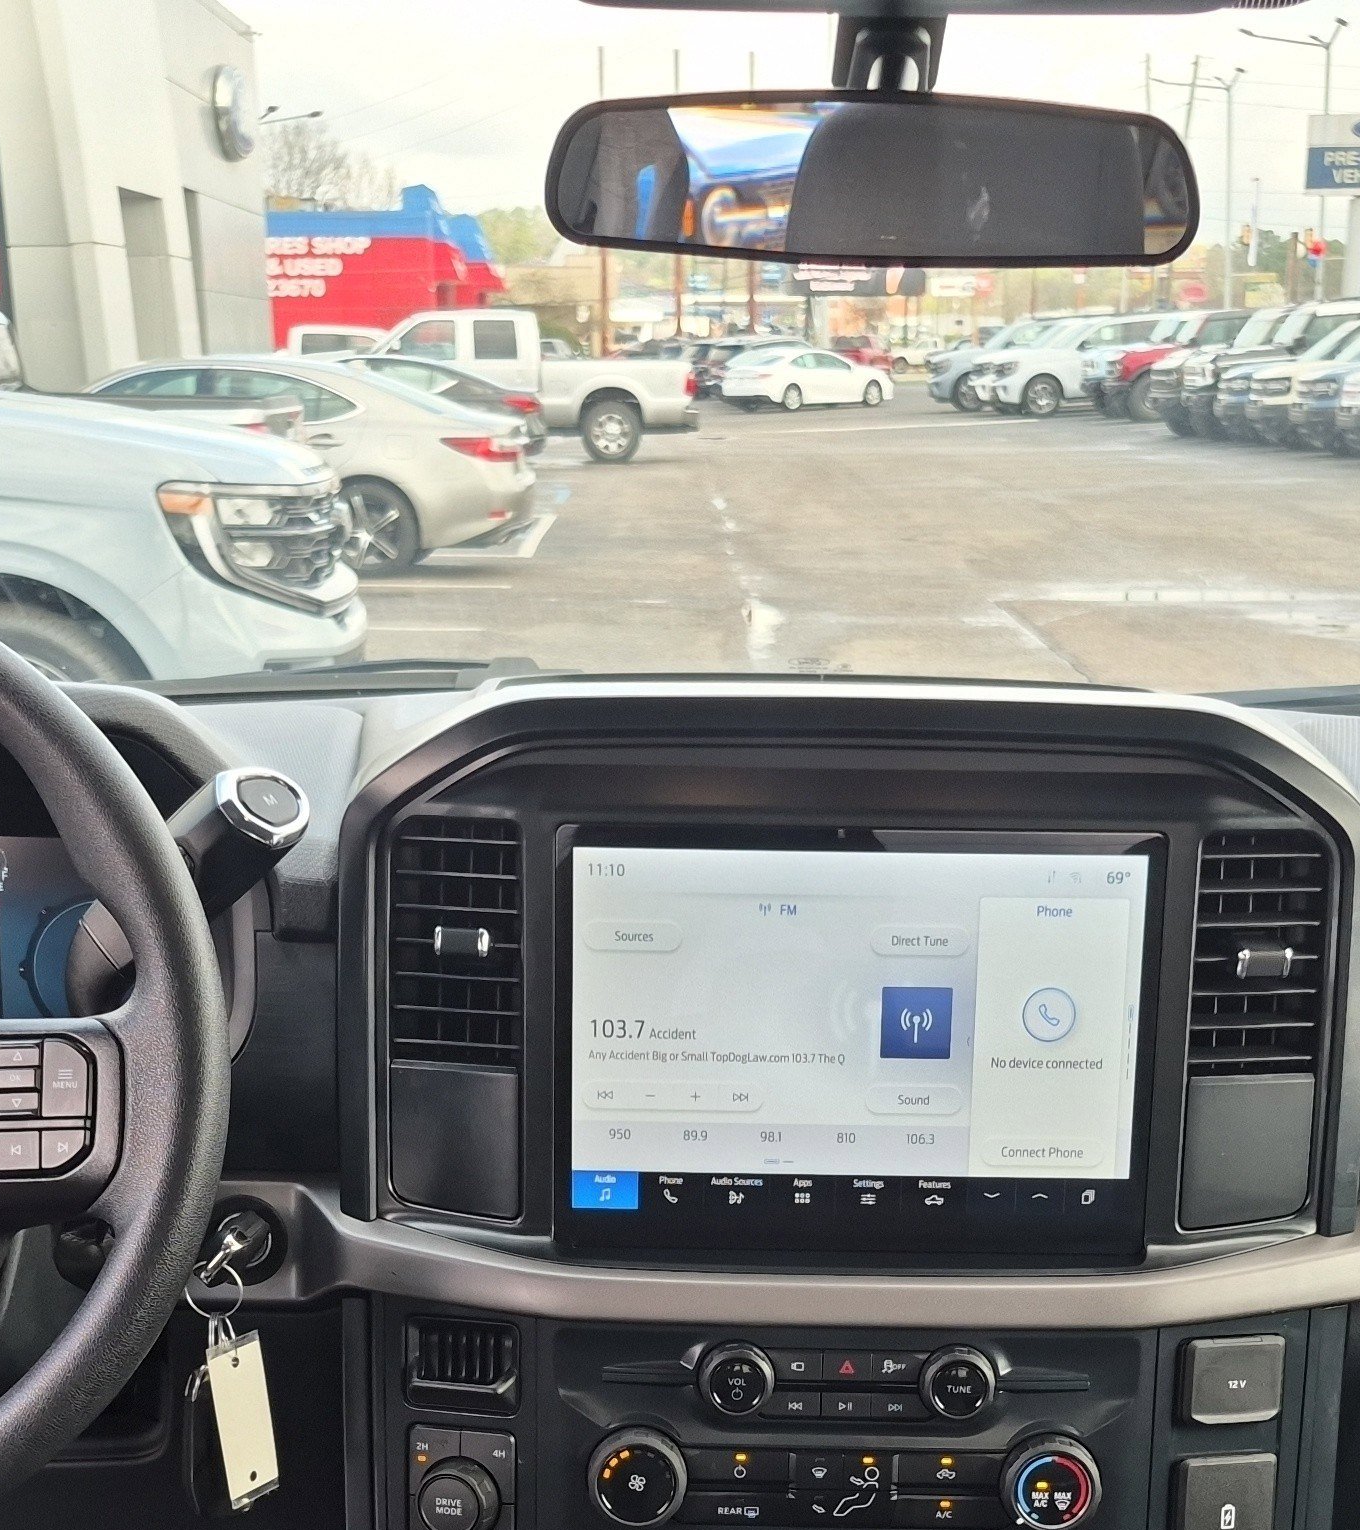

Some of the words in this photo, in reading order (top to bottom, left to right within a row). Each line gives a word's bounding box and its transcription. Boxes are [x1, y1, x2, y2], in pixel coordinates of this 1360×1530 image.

[310, 236, 372, 255] SHOP
[283, 257, 343, 276] USED
[262, 795, 279, 806] M
[1, 870, 9, 881] F
[588, 863, 626, 877] 11:10
[1106, 871, 1131, 885] 69°
[780, 904, 798, 916] FM
[1036, 905, 1073, 918] Phone
[614, 930, 654, 942] Sources
[891, 935, 921, 947] Direct
[923, 935, 949, 947] Tune
[590, 1018, 646, 1039] 103.7
[649, 1027, 697, 1040] Accident
[588, 1049, 607, 1062] Any
[608, 1050, 650, 1061] Accident
[652, 1050, 667, 1063] Big
[669, 1053, 679, 1062] or
[681, 1051, 708, 1062] Small
[710, 1051, 790, 1065] TopDogLaw.com
[791, 1053, 816, 1064] 103.7
[818, 1053, 836, 1064] The
[837, 1053, 846, 1066] Q
[991, 1057, 1006, 1069] No
[1008, 1057, 1044, 1070] device
[1045, 1058, 1103, 1071] connected
[9, 1074, 21, 1082] OK
[52, 1081, 78, 1089] MENU
[897, 1094, 930, 1106] Sound
[608, 1128, 631, 1140] 950
[683, 1129, 708, 1142] 89.9
[760, 1131, 782, 1143] 98.1
[836, 1132, 856, 1144] 810
[906, 1133, 935, 1145] 106.3
[1001, 1146, 1046, 1158] Connect
[1048, 1146, 1084, 1159] Phone
[594, 1174, 617, 1184] Audio
[658, 1175, 684, 1186] Phone
[710, 1176, 733, 1186] Audio
[733, 1176, 763, 1187] Sources
[793, 1177, 813, 1189] Apps
[853, 1178, 885, 1190] Settings
[918, 1179, 951, 1190] Features
[892, 1363, 907, 1371] OFF
[727, 1377, 747, 1386] VOL
[1227, 1380, 1239, 1389] 12
[1239, 1380, 1247, 1389] V
[946, 1385, 972, 1394] TUNE
[416, 1442, 429, 1451] 2H
[492, 1450, 506, 1459] 4H
[1031, 1491, 1050, 1500] MAX
[1053, 1491, 1072, 1500] MAX
[435, 1497, 462, 1508] DRIVE
[1033, 1499, 1048, 1508] A/C
[435, 1506, 463, 1516] MODE
[717, 1506, 742, 1515] REAR
[935, 1510, 953, 1520] A/C
